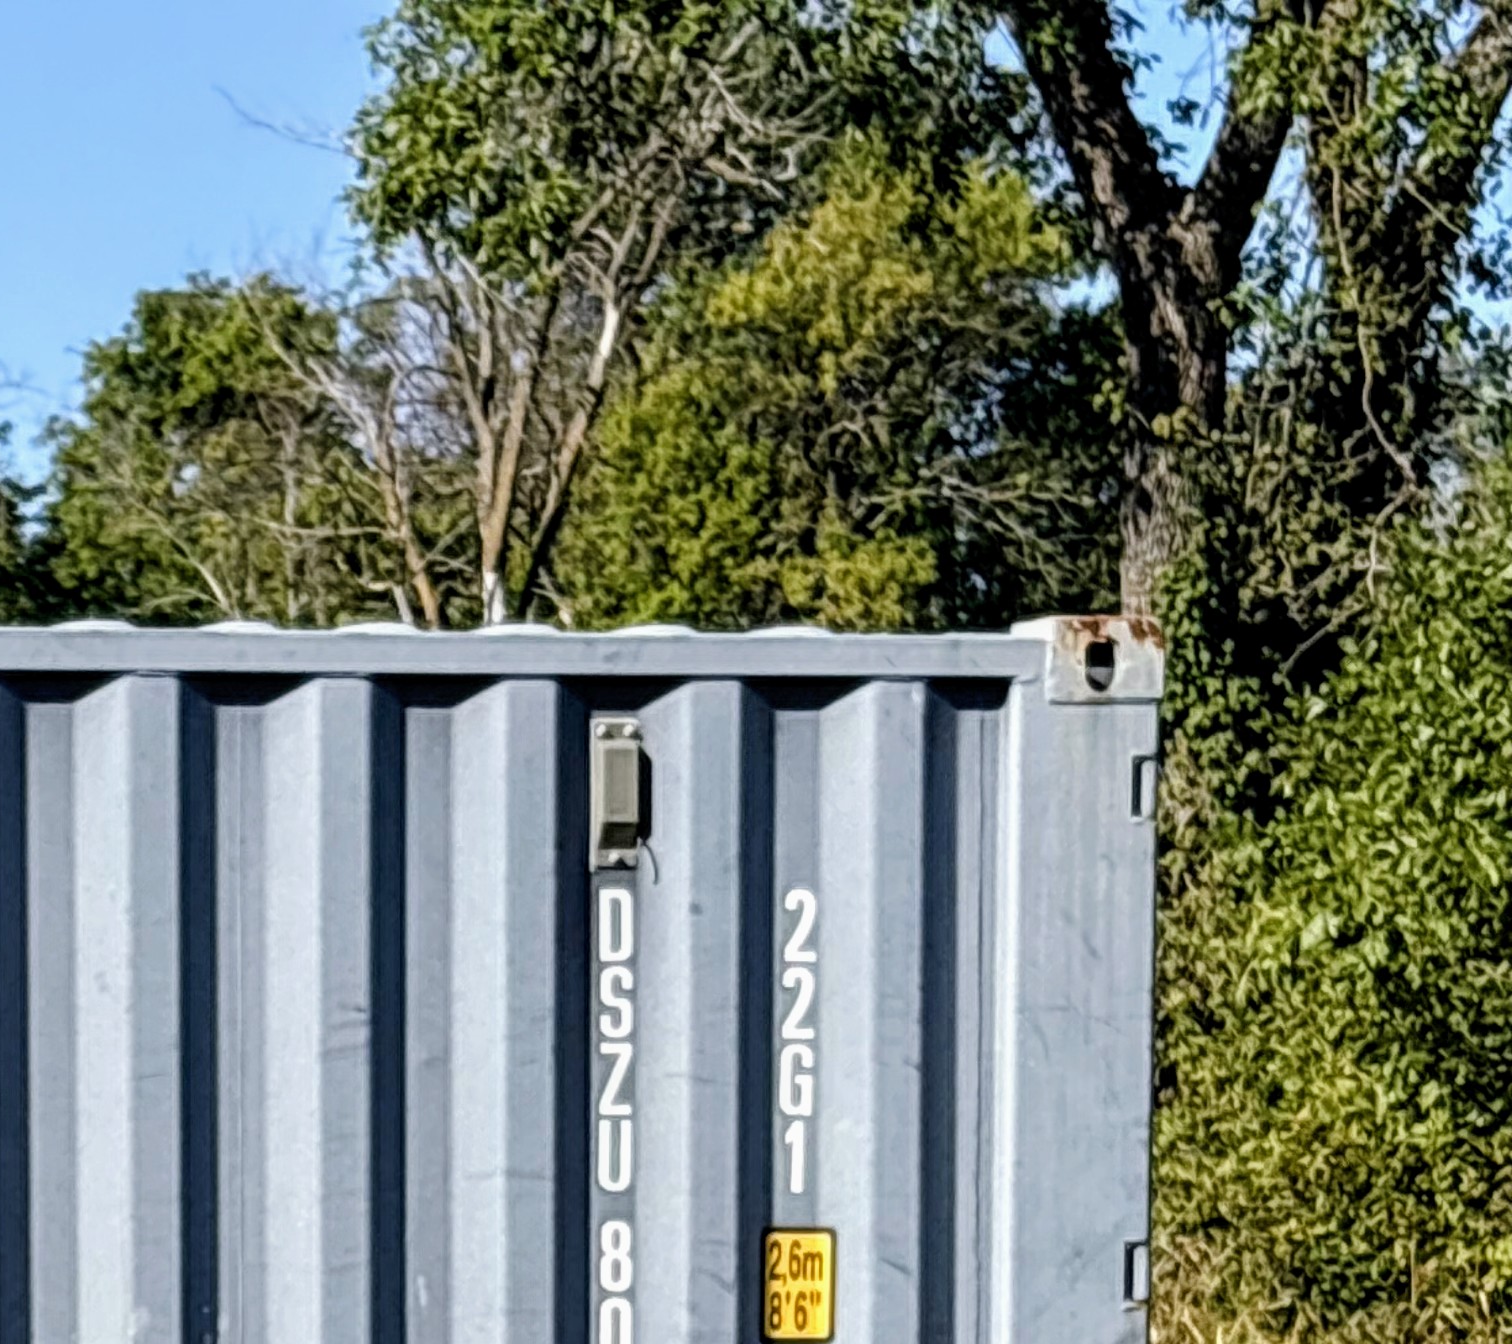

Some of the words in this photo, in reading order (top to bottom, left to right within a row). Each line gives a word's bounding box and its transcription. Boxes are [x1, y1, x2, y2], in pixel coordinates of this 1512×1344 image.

[596, 887, 635, 1192] DSZU
[778, 888, 818, 1194] 22G1
[768, 1238, 824, 1286] 2,6m
[769, 1290, 823, 1333] 8'6"
